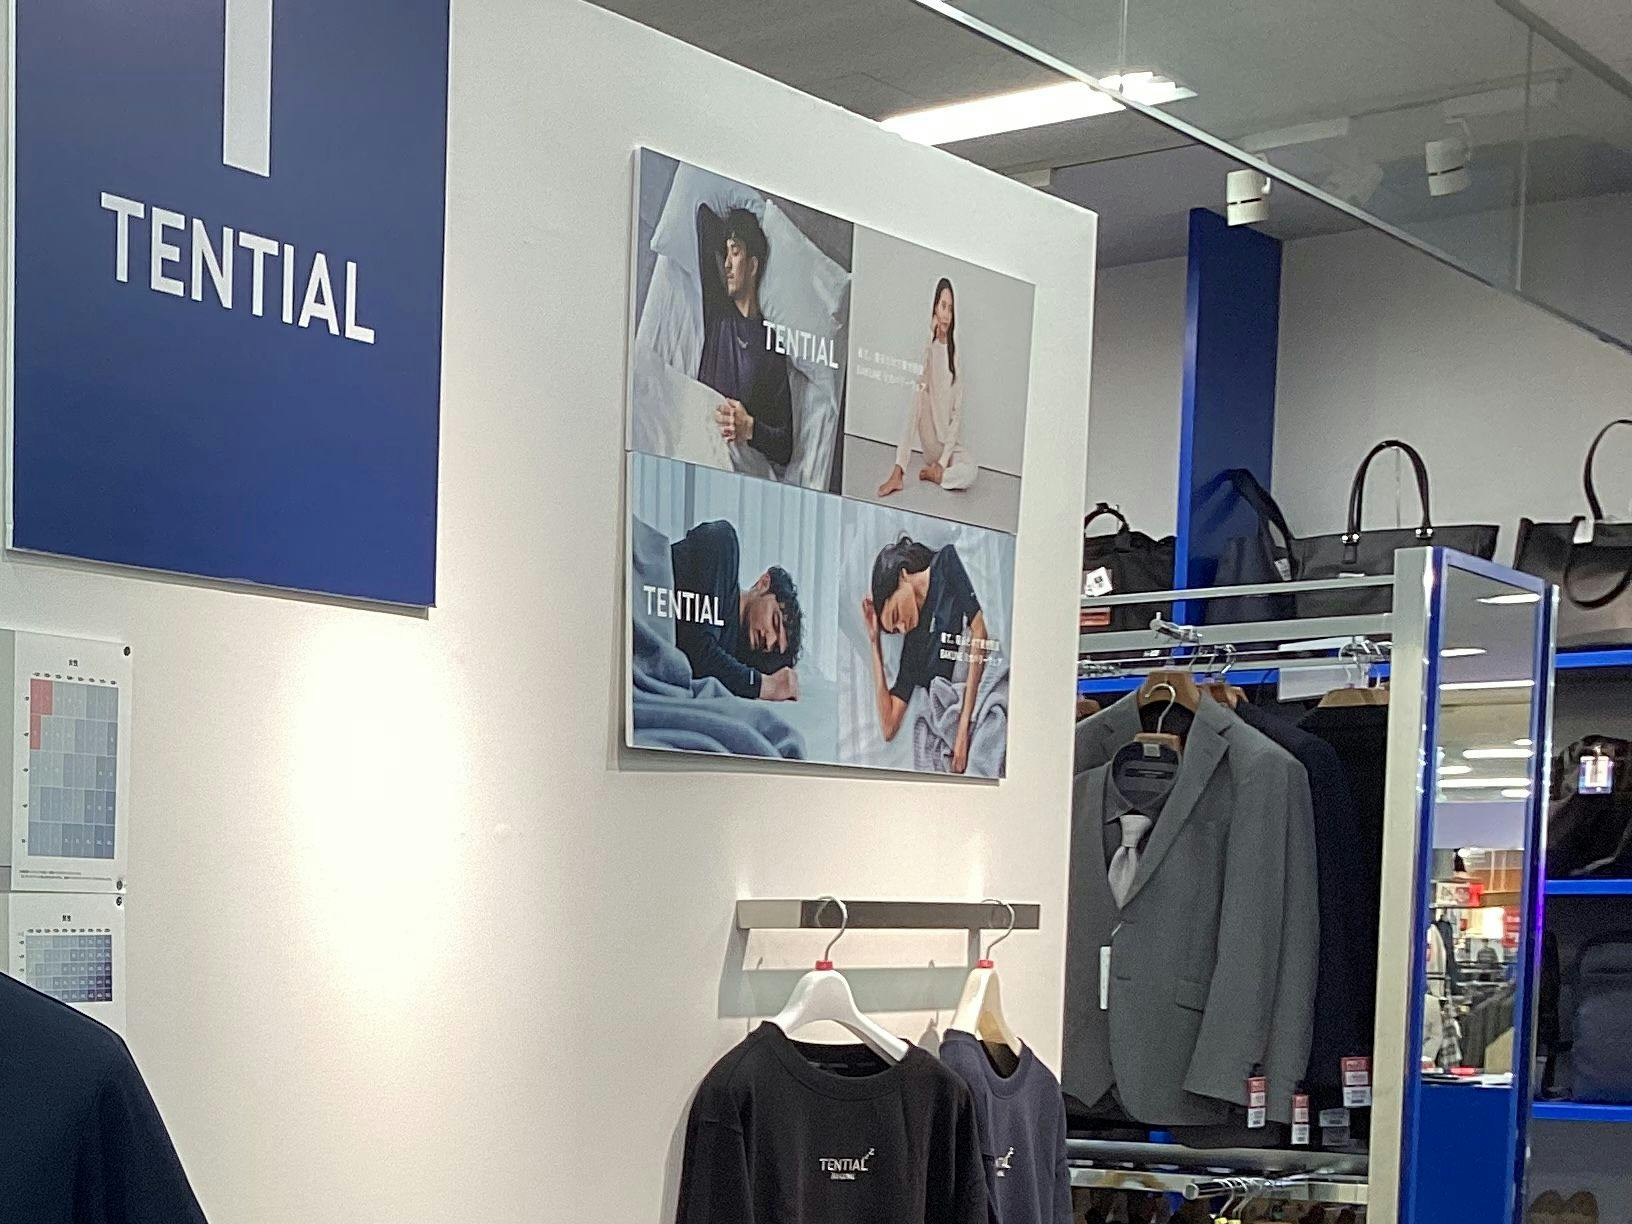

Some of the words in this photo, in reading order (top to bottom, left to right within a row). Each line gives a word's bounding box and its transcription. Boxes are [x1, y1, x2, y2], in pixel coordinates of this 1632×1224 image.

[100, 191, 376, 345] TENTIAL
[762, 319, 839, 370] TENTIAL
[643, 585, 725, 627] TENTIAL
[818, 1157, 869, 1172] TENTIAL
